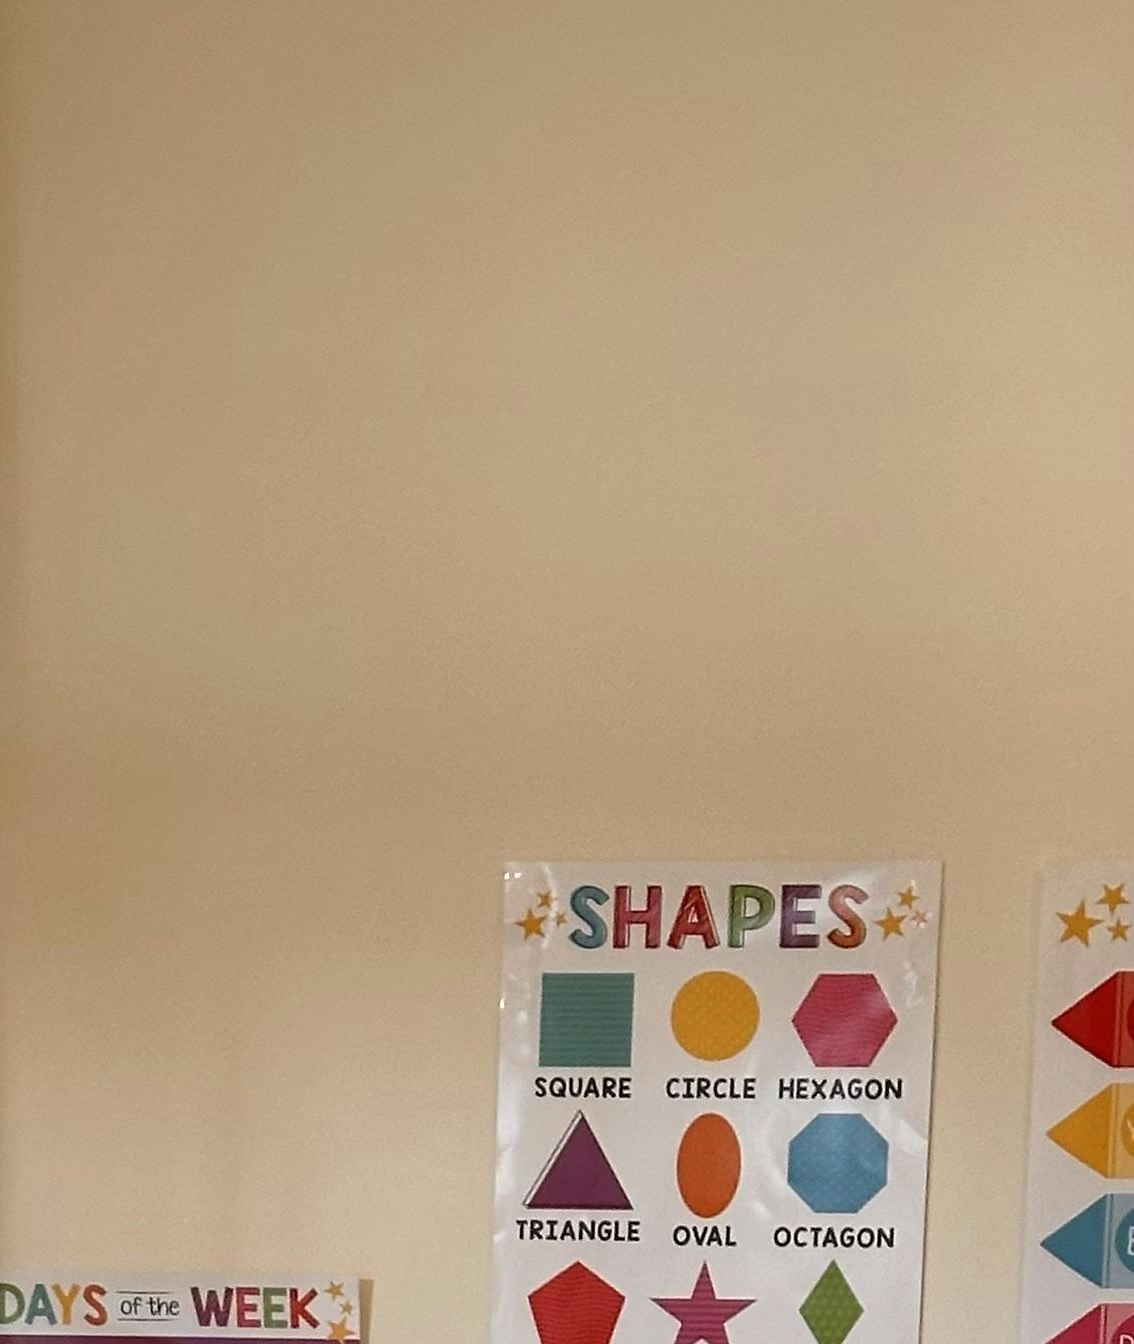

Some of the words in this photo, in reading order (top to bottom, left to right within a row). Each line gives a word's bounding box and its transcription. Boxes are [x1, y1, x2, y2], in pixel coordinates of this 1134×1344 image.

[568, 884, 868, 950] SHAPES
[535, 1077, 632, 1099] SQUARE
[666, 1077, 756, 1099] CIRCLE
[778, 1078, 903, 1099] HEXAGON
[517, 1220, 640, 1242] TRIANGLE
[673, 1225, 736, 1247] OVAL
[774, 1227, 895, 1248] OCTAGON
[120, 1296, 143, 1317] of
[146, 1295, 180, 1316] the
[191, 1286, 321, 1329] WEEK
